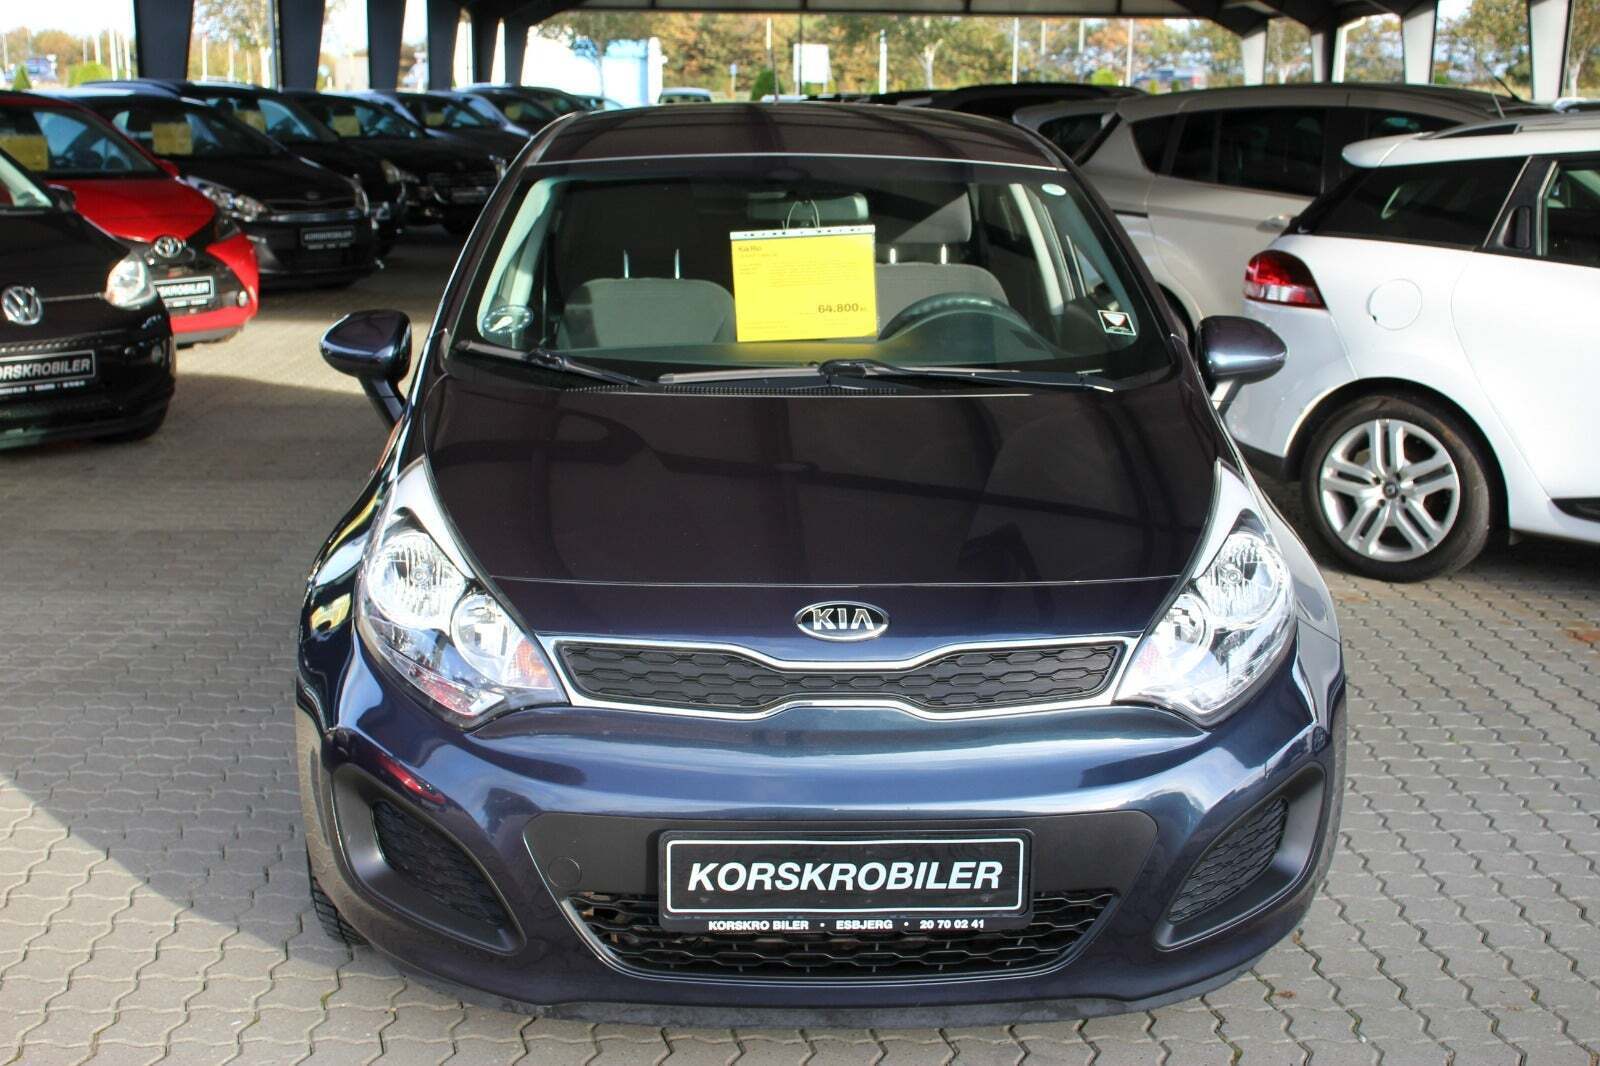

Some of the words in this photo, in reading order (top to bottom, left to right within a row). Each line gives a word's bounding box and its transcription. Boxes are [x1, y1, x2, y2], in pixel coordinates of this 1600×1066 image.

[817, 303, 859, 314] 64.800
[812, 608, 874, 630] KIA
[687, 861, 1003, 891] KORSKROBILER
[708, 920, 770, 930] KORSKRO
[772, 920, 809, 930] BILER
[836, 919, 893, 930] ESBJERG
[919, 919, 934, 929] 20
[937, 919, 951, 929] 70
[954, 919, 968, 929] 02
[970, 919, 985, 929] 41
